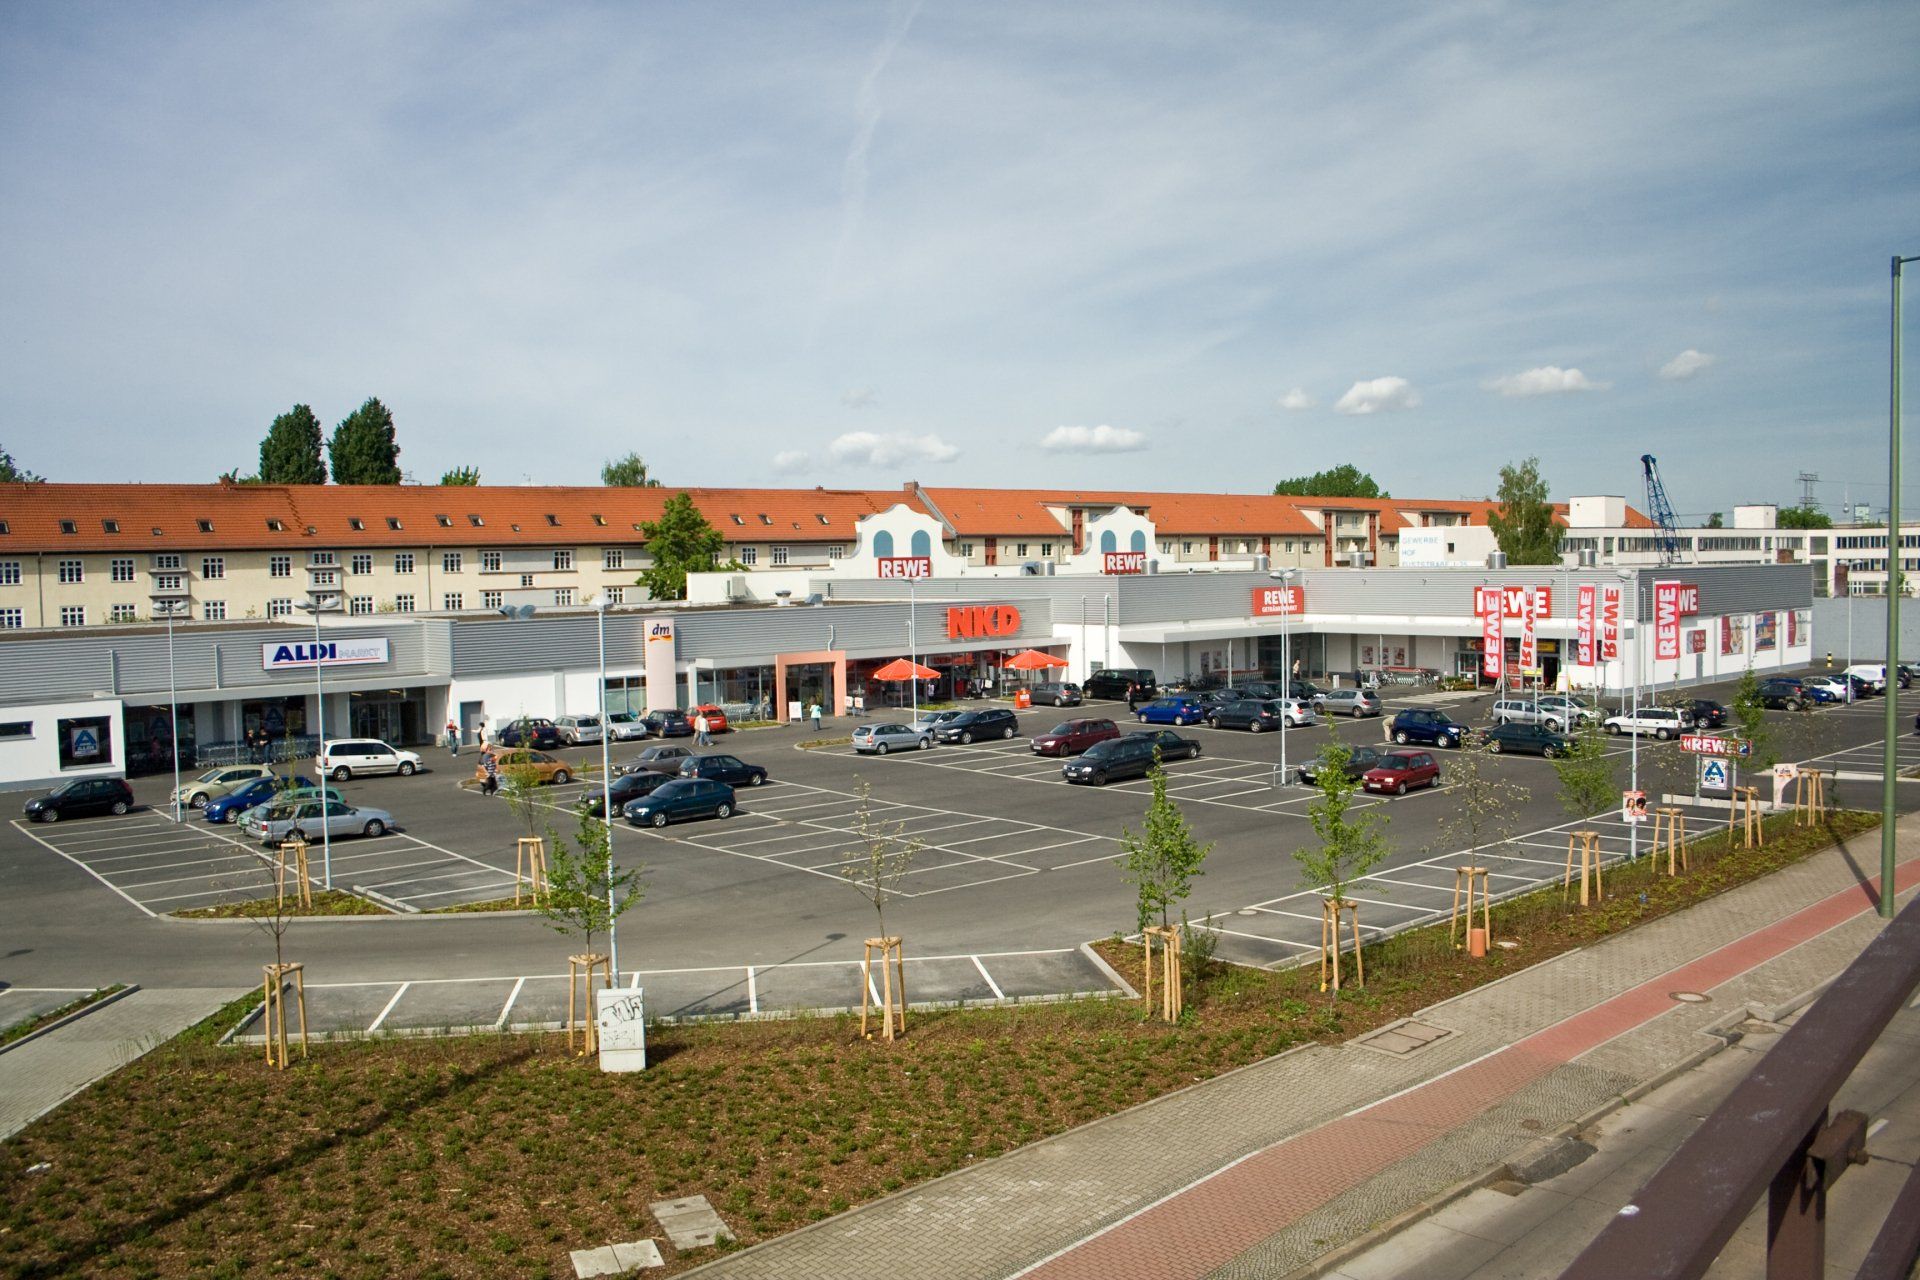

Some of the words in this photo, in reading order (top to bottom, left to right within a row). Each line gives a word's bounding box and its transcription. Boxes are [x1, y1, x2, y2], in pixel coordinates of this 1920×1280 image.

[881, 559, 929, 577] REWE
[1264, 590, 1295, 604] REWE
[652, 623, 670, 635] dm
[947, 605, 1022, 640] NKD
[1659, 588, 1676, 656] REWE
[273, 643, 336, 662] ALDI
